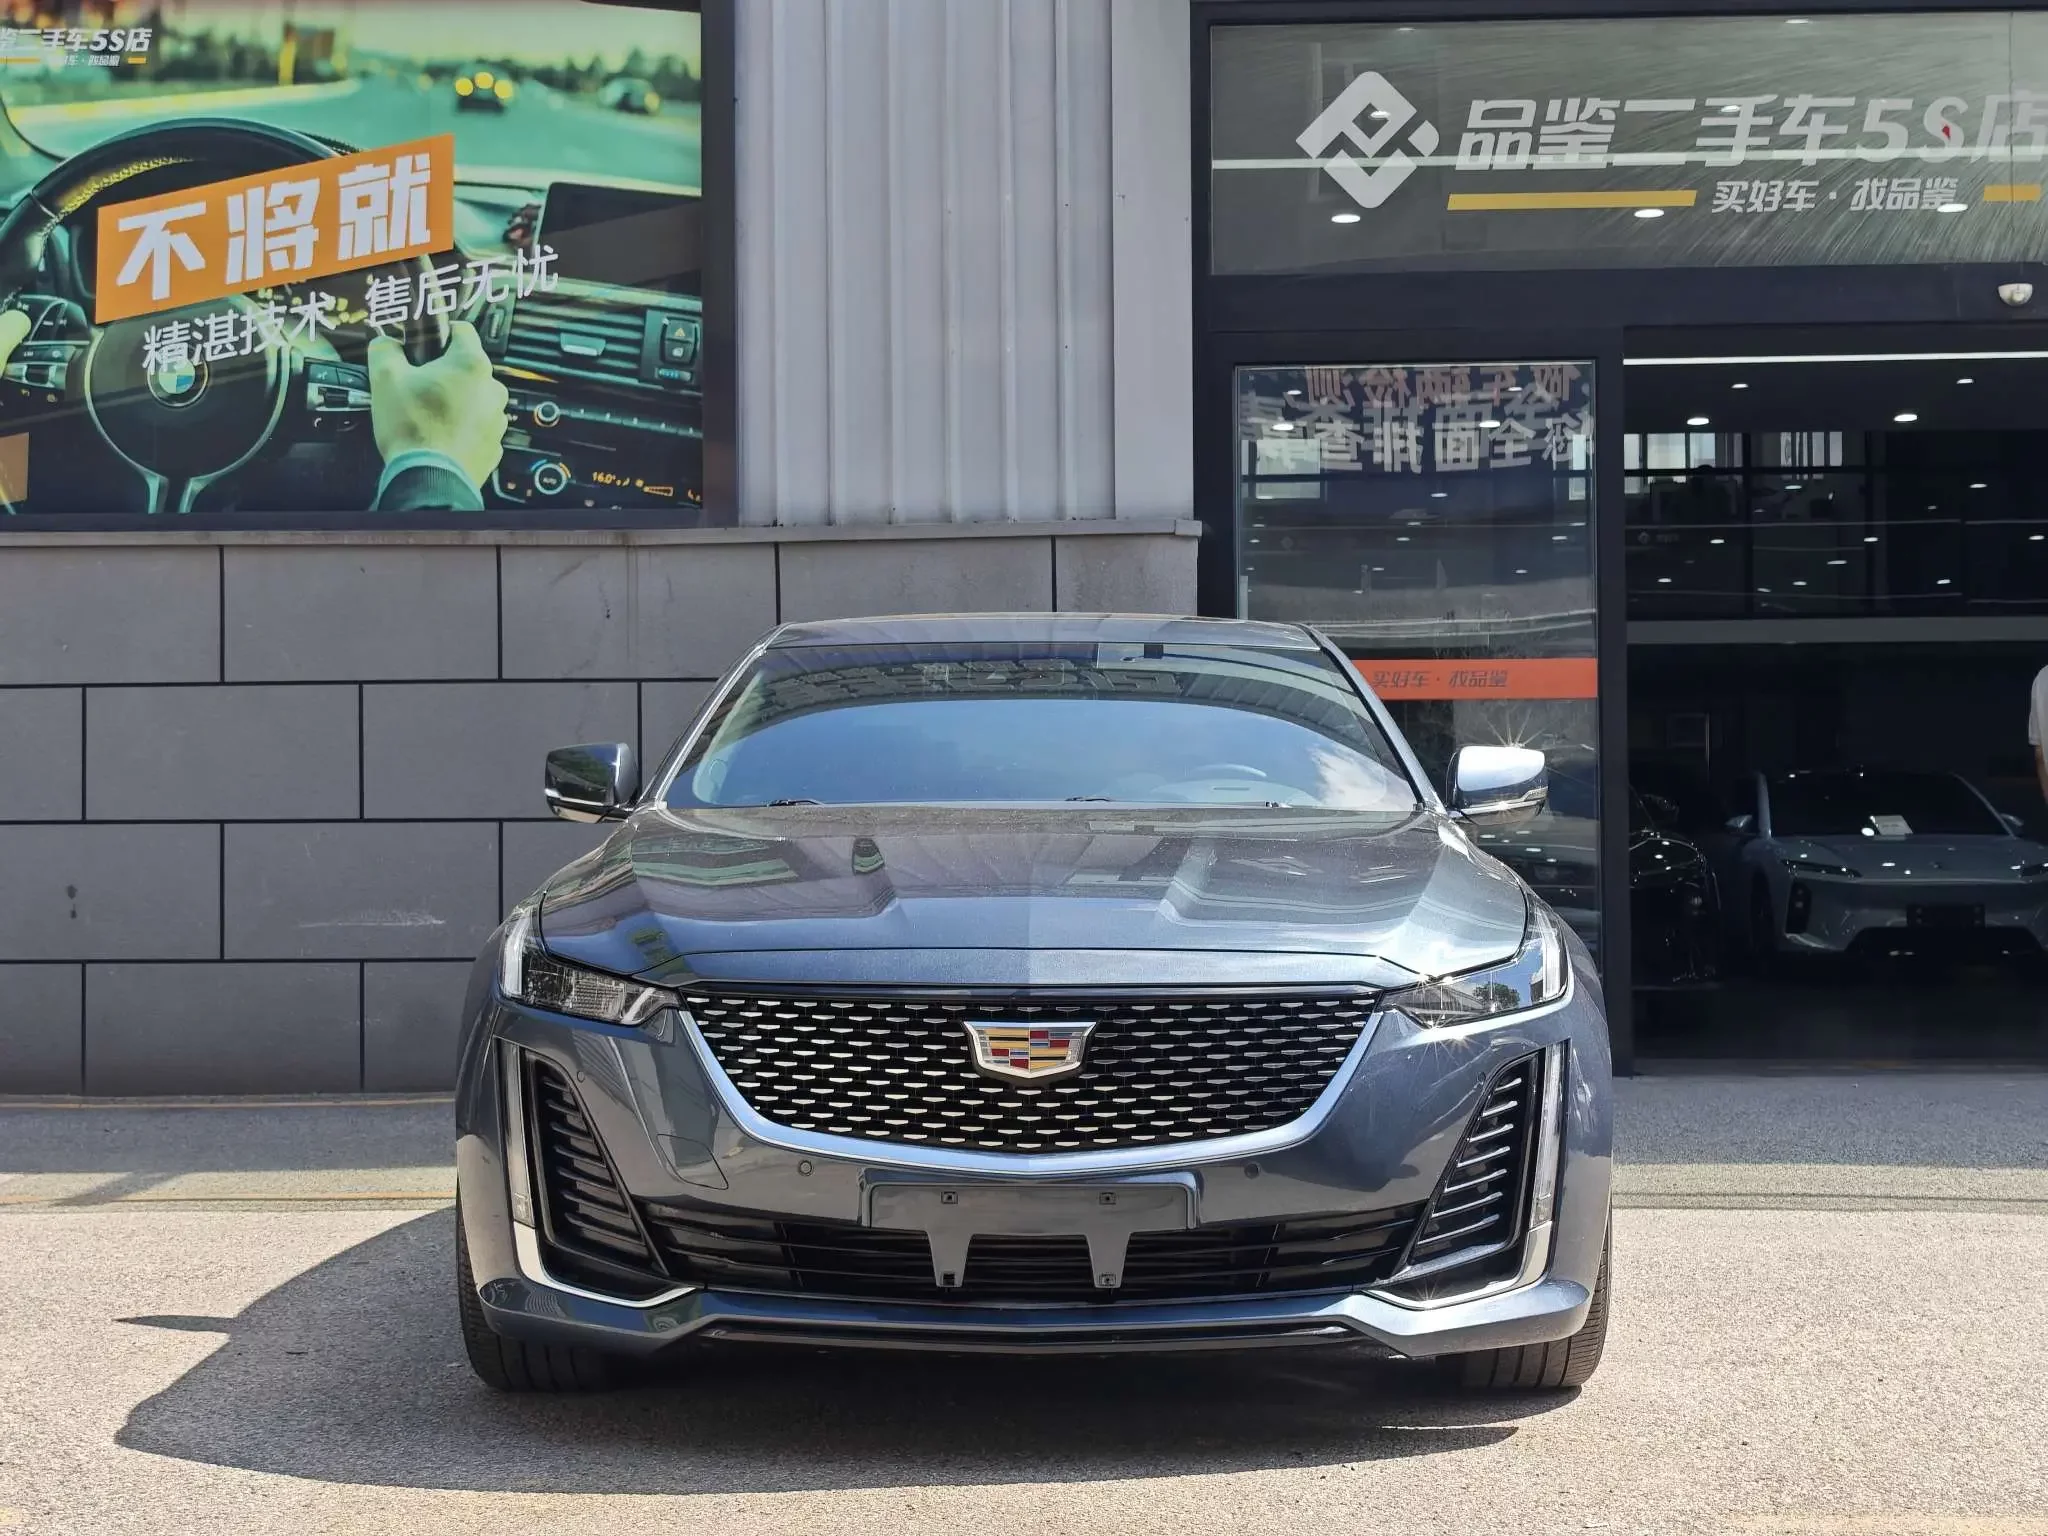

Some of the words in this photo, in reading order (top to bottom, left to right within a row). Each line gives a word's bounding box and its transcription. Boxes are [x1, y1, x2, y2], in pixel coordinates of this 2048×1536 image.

[1455, 90, 2048, 171] 品鉴二手车5S店
[116, 152, 431, 301] 不将就
